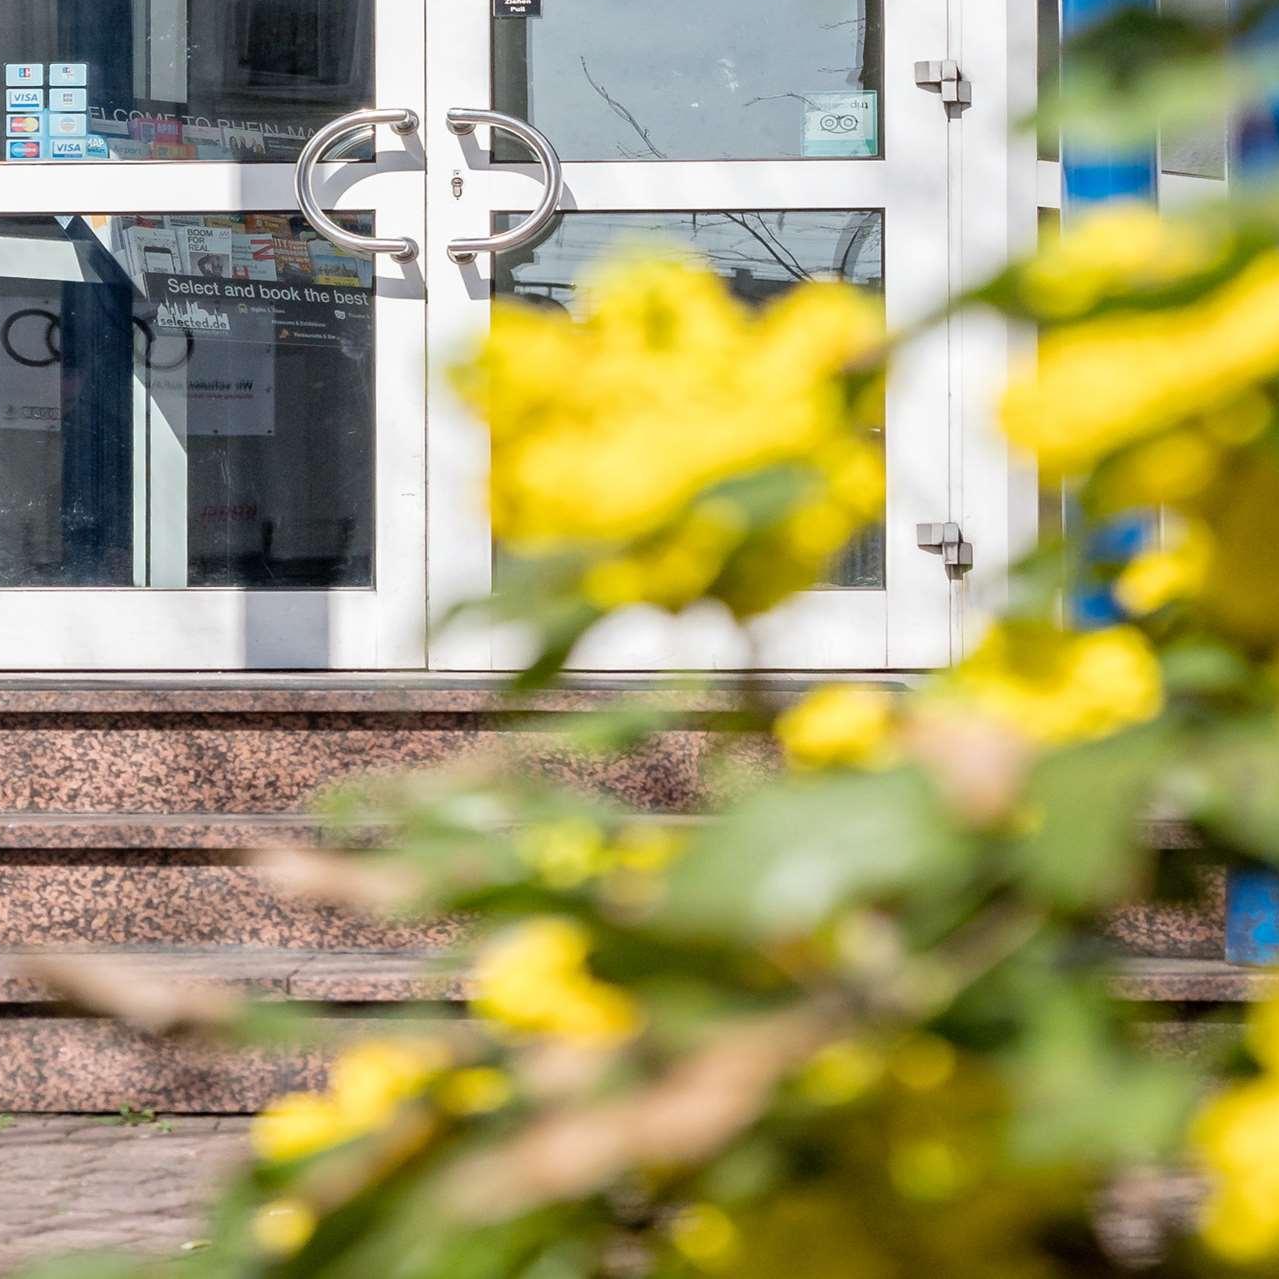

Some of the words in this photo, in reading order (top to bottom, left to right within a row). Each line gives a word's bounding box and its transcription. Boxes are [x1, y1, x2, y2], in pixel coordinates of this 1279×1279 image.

[14, 93, 38, 102] VISA
[56, 143, 81, 152] VISA
[187, 228, 213, 238] BOOM
[188, 236, 205, 244] FOR
[188, 244, 208, 252] REAL
[167, 278, 221, 296] Select
[224, 284, 256, 298] and
[259, 285, 302, 301] book
[303, 288, 330, 303] the
[333, 289, 369, 306] best
[159, 317, 227, 329] selected.de
